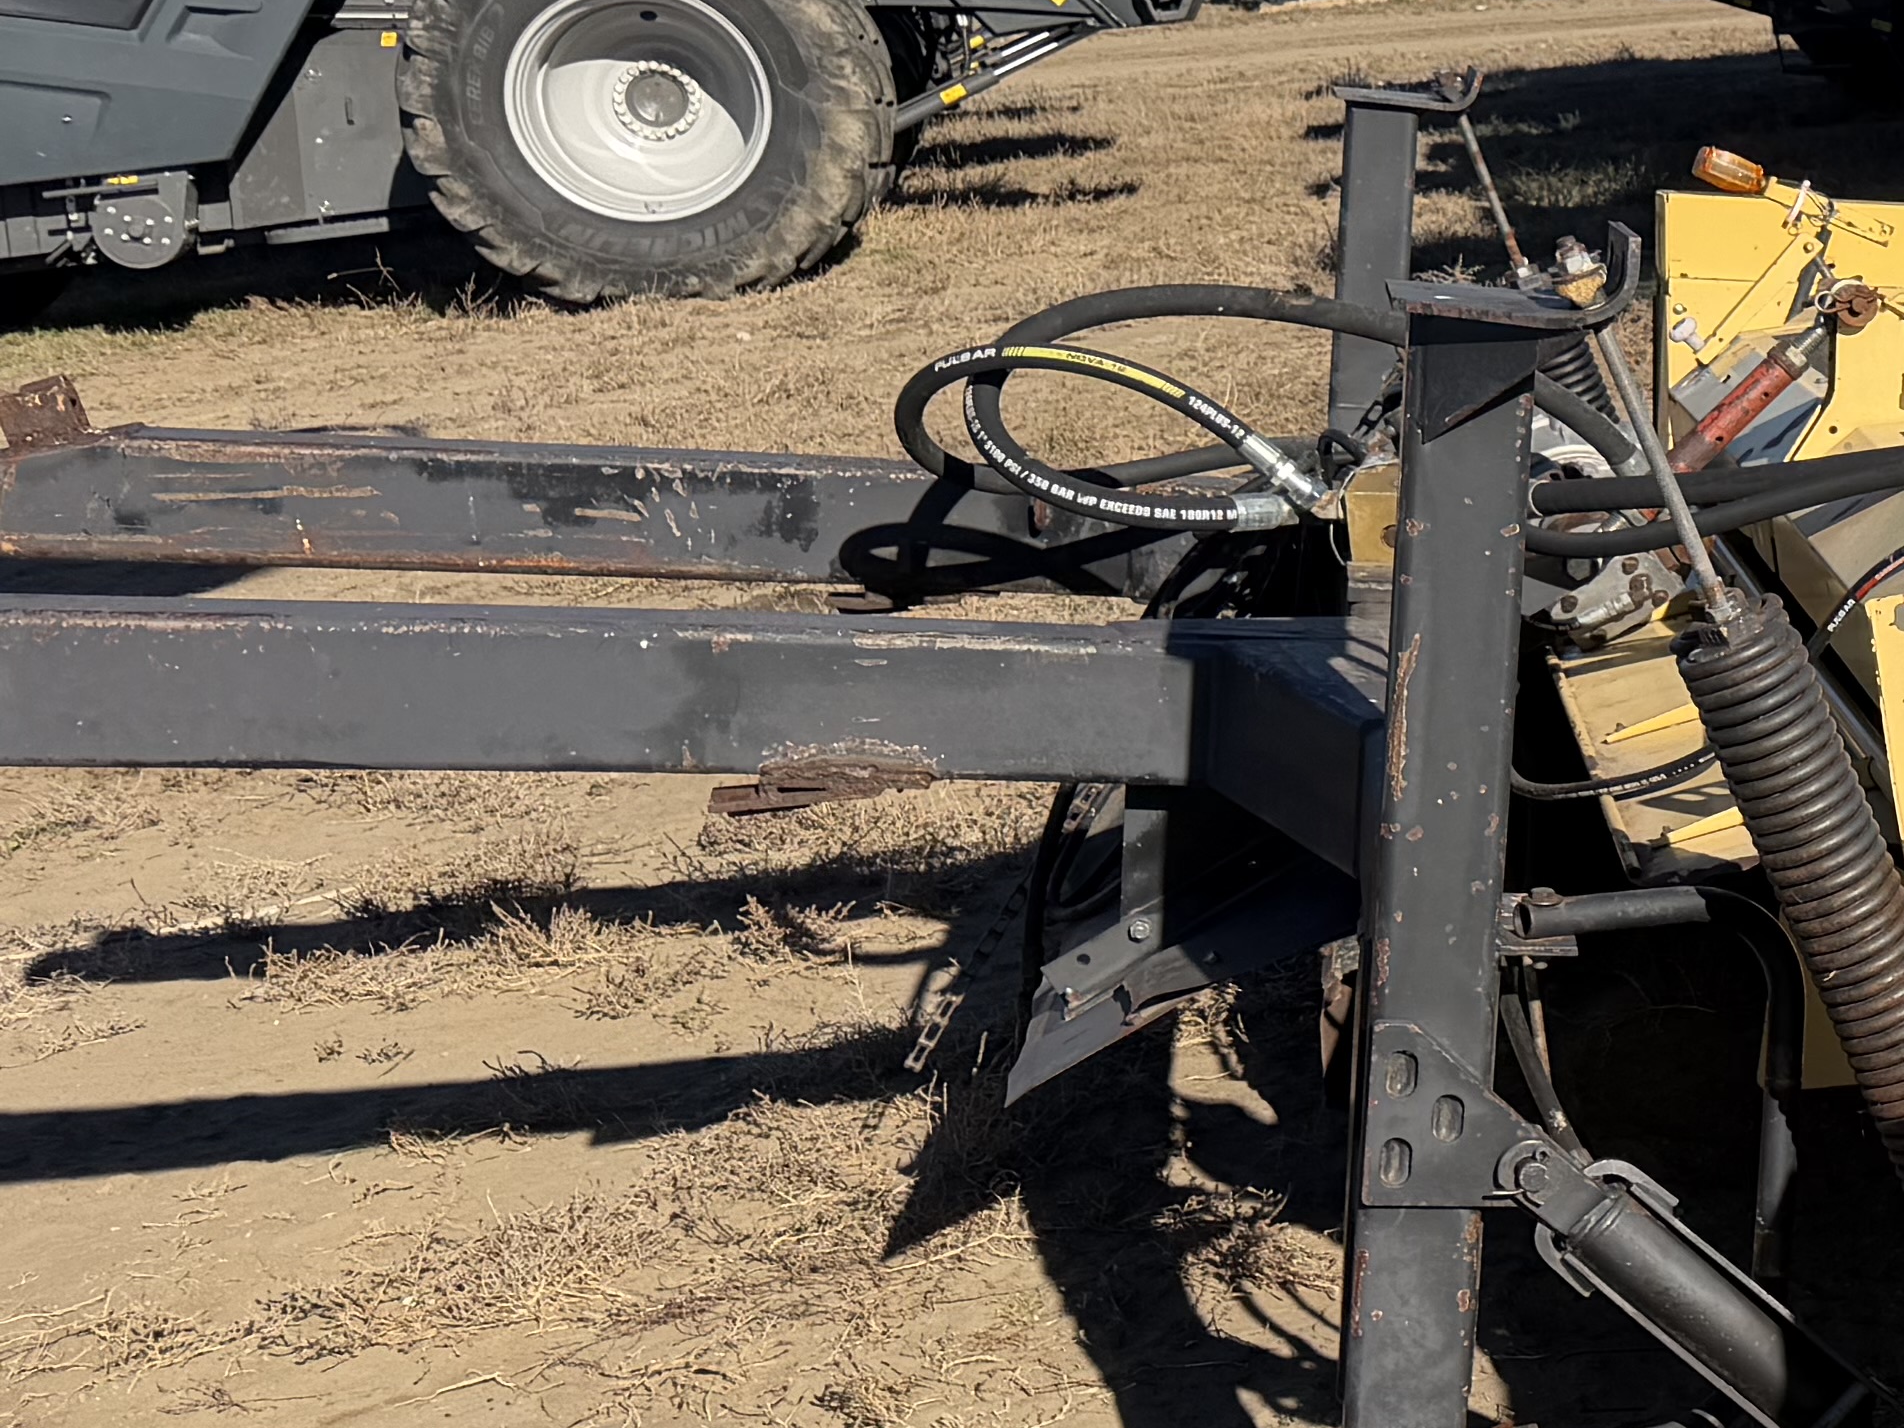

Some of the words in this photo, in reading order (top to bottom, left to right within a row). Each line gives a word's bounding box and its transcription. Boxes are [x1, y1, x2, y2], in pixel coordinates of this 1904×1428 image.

[934, 347, 997, 372] PULSAR
[1049, 483, 1076, 502] BAR
[1099, 499, 1151, 518] EXCEEDS
[1153, 508, 1177, 520] SAE
